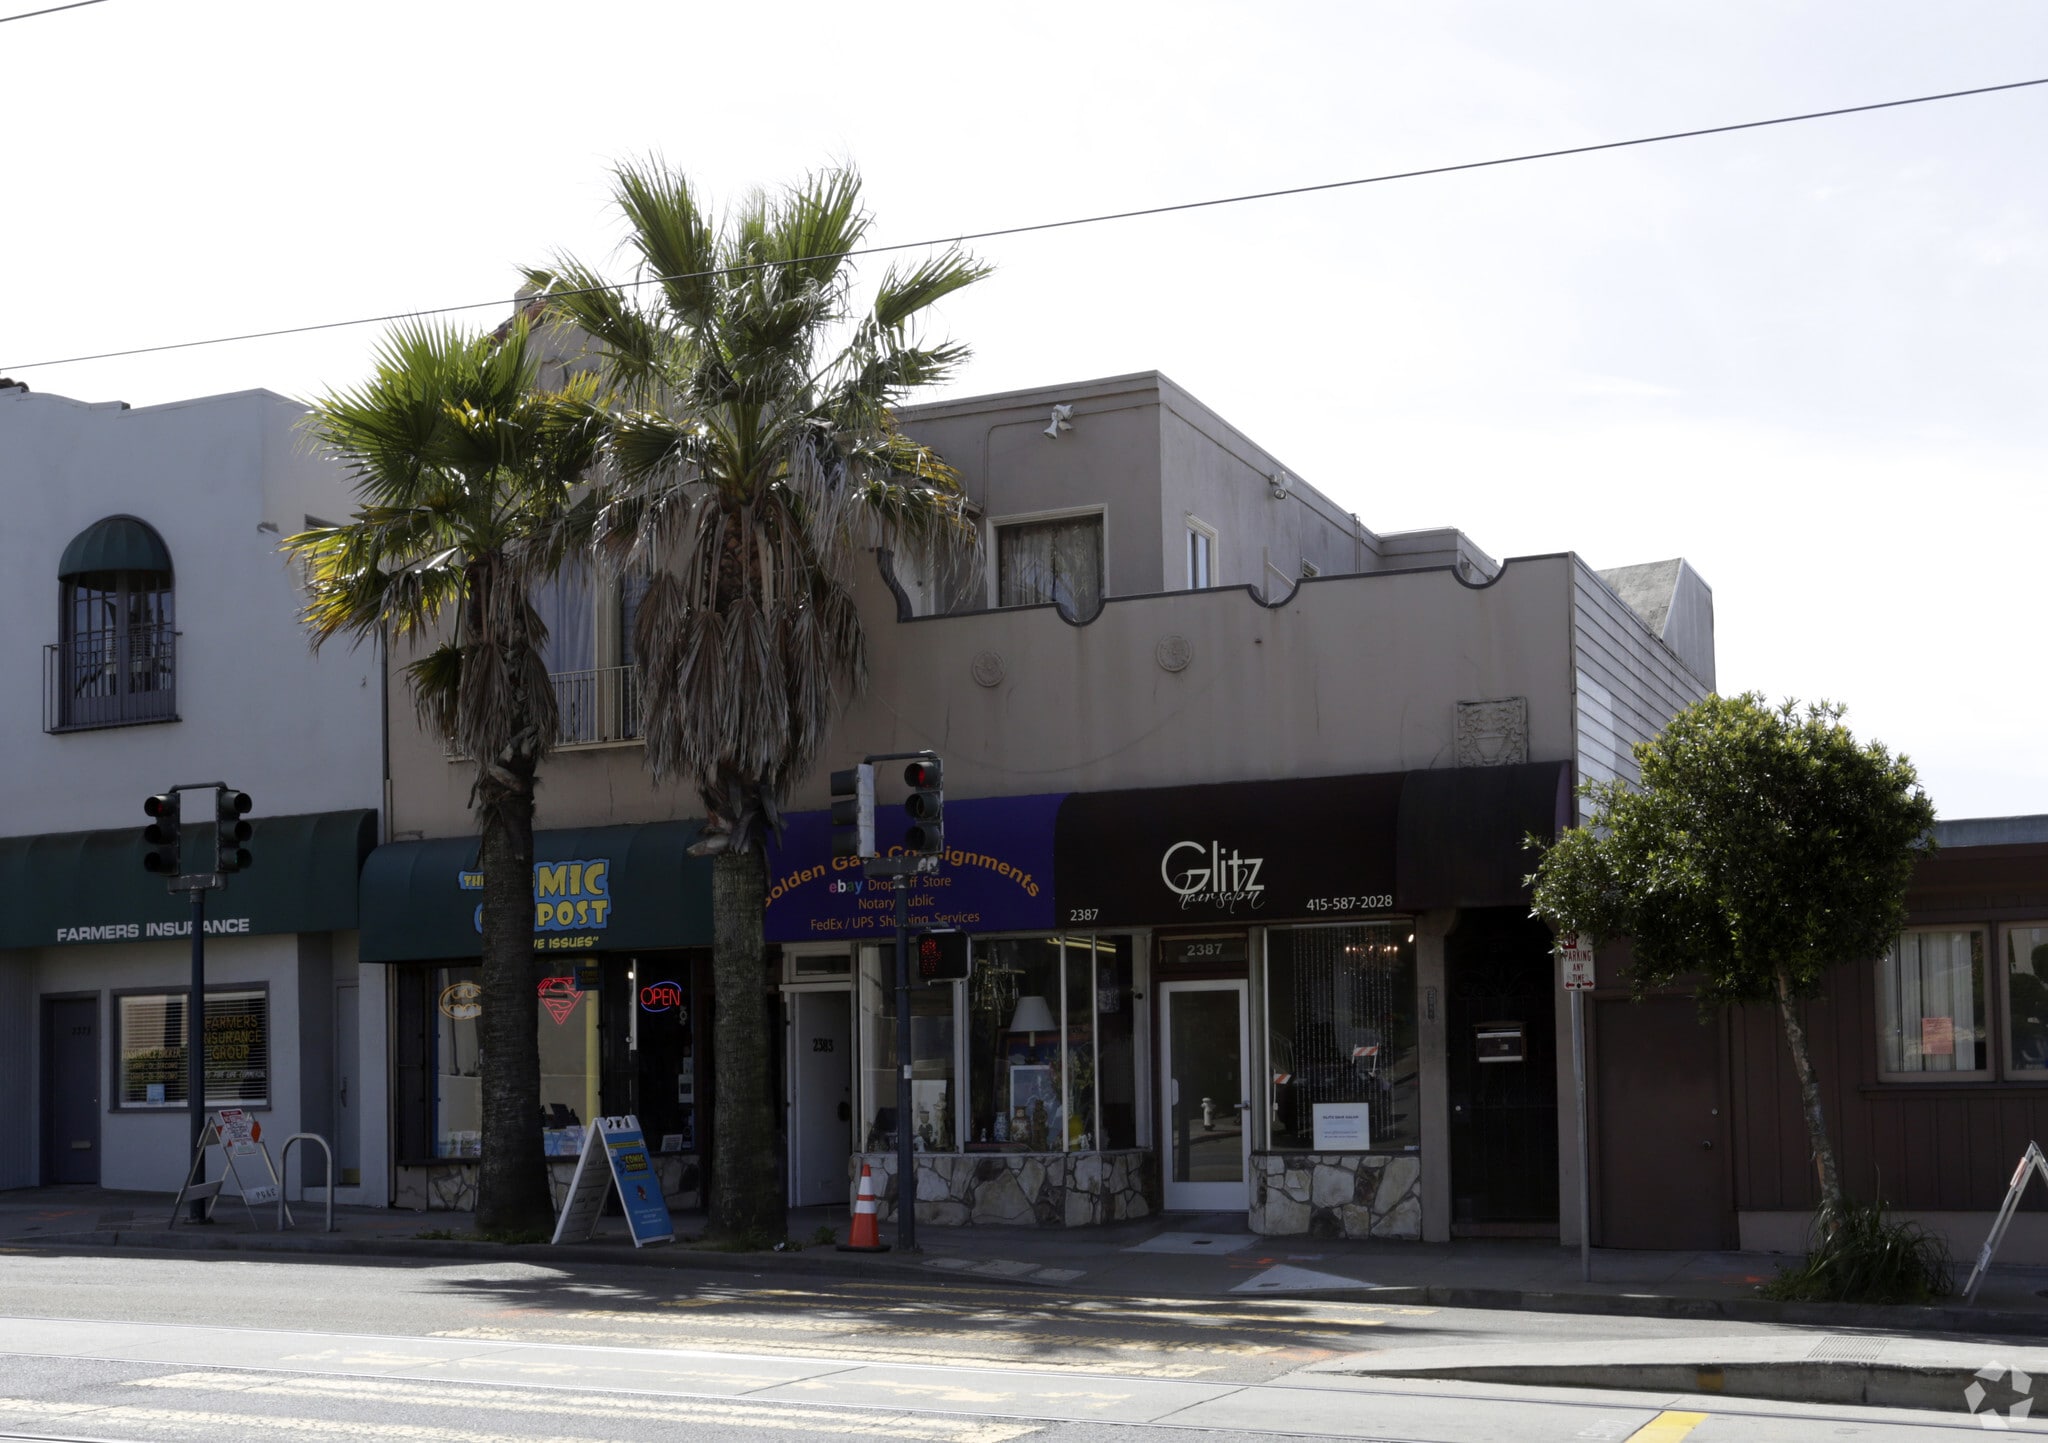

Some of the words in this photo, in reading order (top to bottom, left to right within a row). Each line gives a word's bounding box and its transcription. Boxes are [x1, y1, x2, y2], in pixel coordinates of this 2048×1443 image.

[1161, 840, 1265, 895] Glitz
[532, 861, 606, 898] MIC
[829, 879, 863, 895] ebay
[922, 875, 951, 888] Store
[1174, 872, 1216, 910] hair
[1215, 868, 1266, 914] salon
[858, 898, 896, 911] Notary
[907, 893, 935, 907] ublic
[1306, 894, 1393, 911] 415-587-2028
[810, 918, 842, 931] FedEx
[851, 915, 873, 929] UPS
[879, 913, 929, 927] Shiing
[934, 911, 980, 924] Services
[1070, 908, 1099, 922] 2387
[56, 923, 139, 942] FARMERS
[1187, 944, 1223, 957] 2387
[1564, 950, 1591, 961] PARKING
[1573, 963, 1583, 971] ANY
[1573, 974, 1584, 982] TIME
[640, 986, 682, 1007] OPEN
[204, 1014, 258, 1030] FARMERS
[203, 1030, 262, 1045] NSURANCE
[211, 1045, 250, 1061] GROUP
